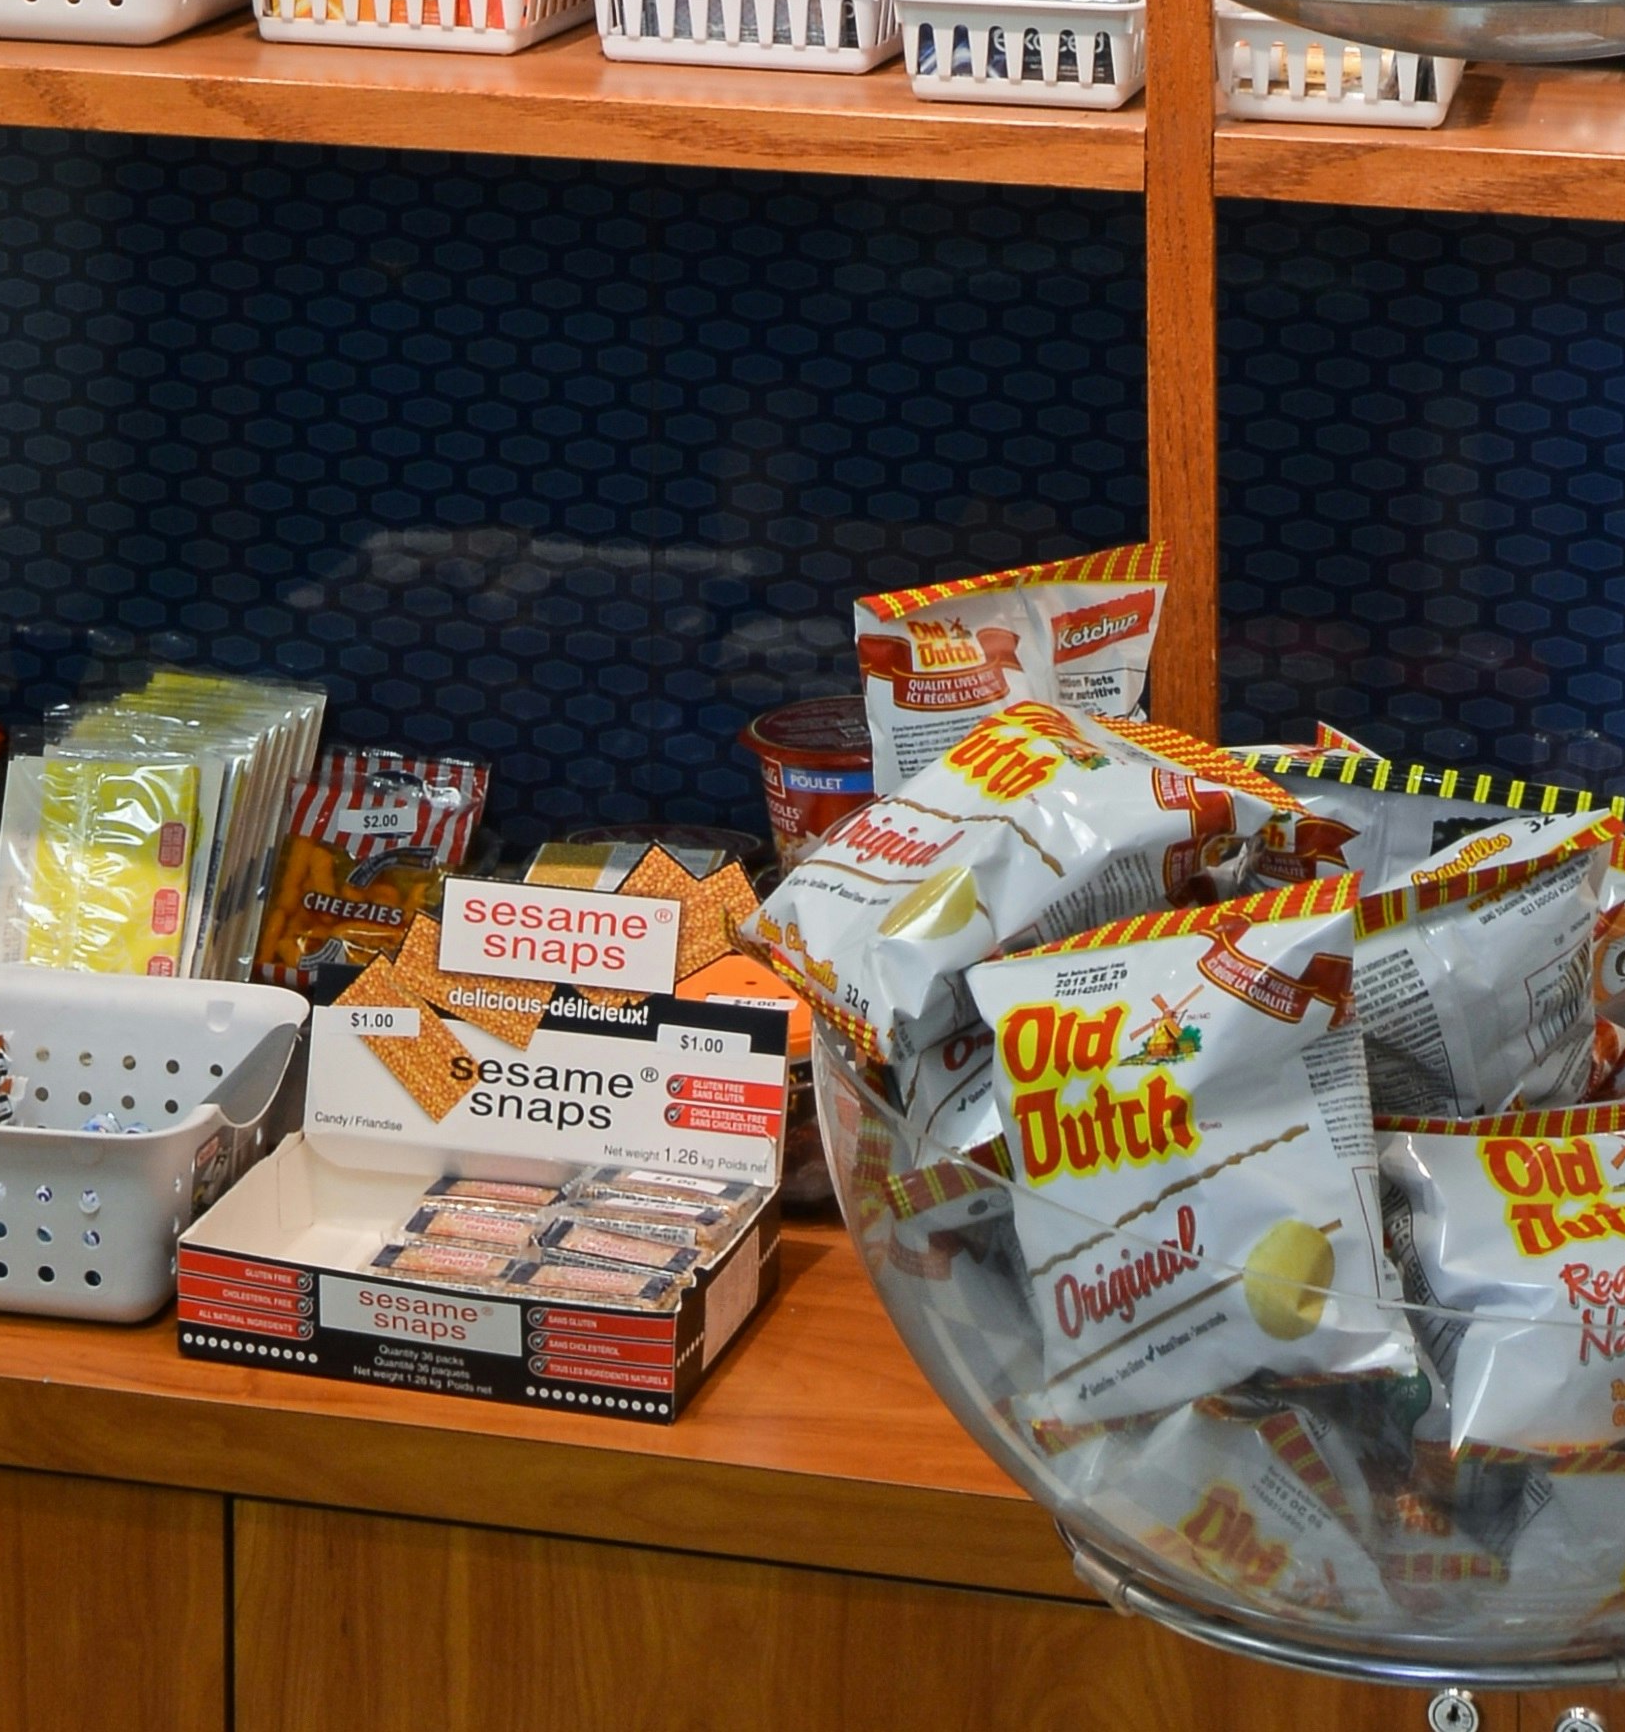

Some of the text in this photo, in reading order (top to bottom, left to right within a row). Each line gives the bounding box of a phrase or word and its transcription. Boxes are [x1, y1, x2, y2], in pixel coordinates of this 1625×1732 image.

[1057, 612, 1139, 650] Ketchup
[790, 772, 843, 790] POULET
[363, 814, 398, 828] $2.00
[303, 892, 403, 925] CHEEZIES
[463, 898, 648, 939] sesame
[483, 933, 626, 974] snaps
[844, 983, 859, 1004] 32
[1056, 968, 1128, 988] 2015 29
[350, 1012, 393, 1028] $1.00
[448, 987, 649, 1026] delicious-délicieux!
[680, 1035, 724, 1053] $1.00
[1004, 1004, 1124, 1084] Old
[450, 1054, 634, 1099] sesame
[314, 1111, 402, 1131] Candy Friandise
[469, 1091, 613, 1130] snaps
[1013, 1075, 1194, 1180] Dutch
[603, 1144, 748, 1172] Net weight 1.26 Poids
[1484, 1138, 1604, 1198] Old
[359, 1288, 478, 1322] sesame
[373, 1310, 467, 1341] snaps
